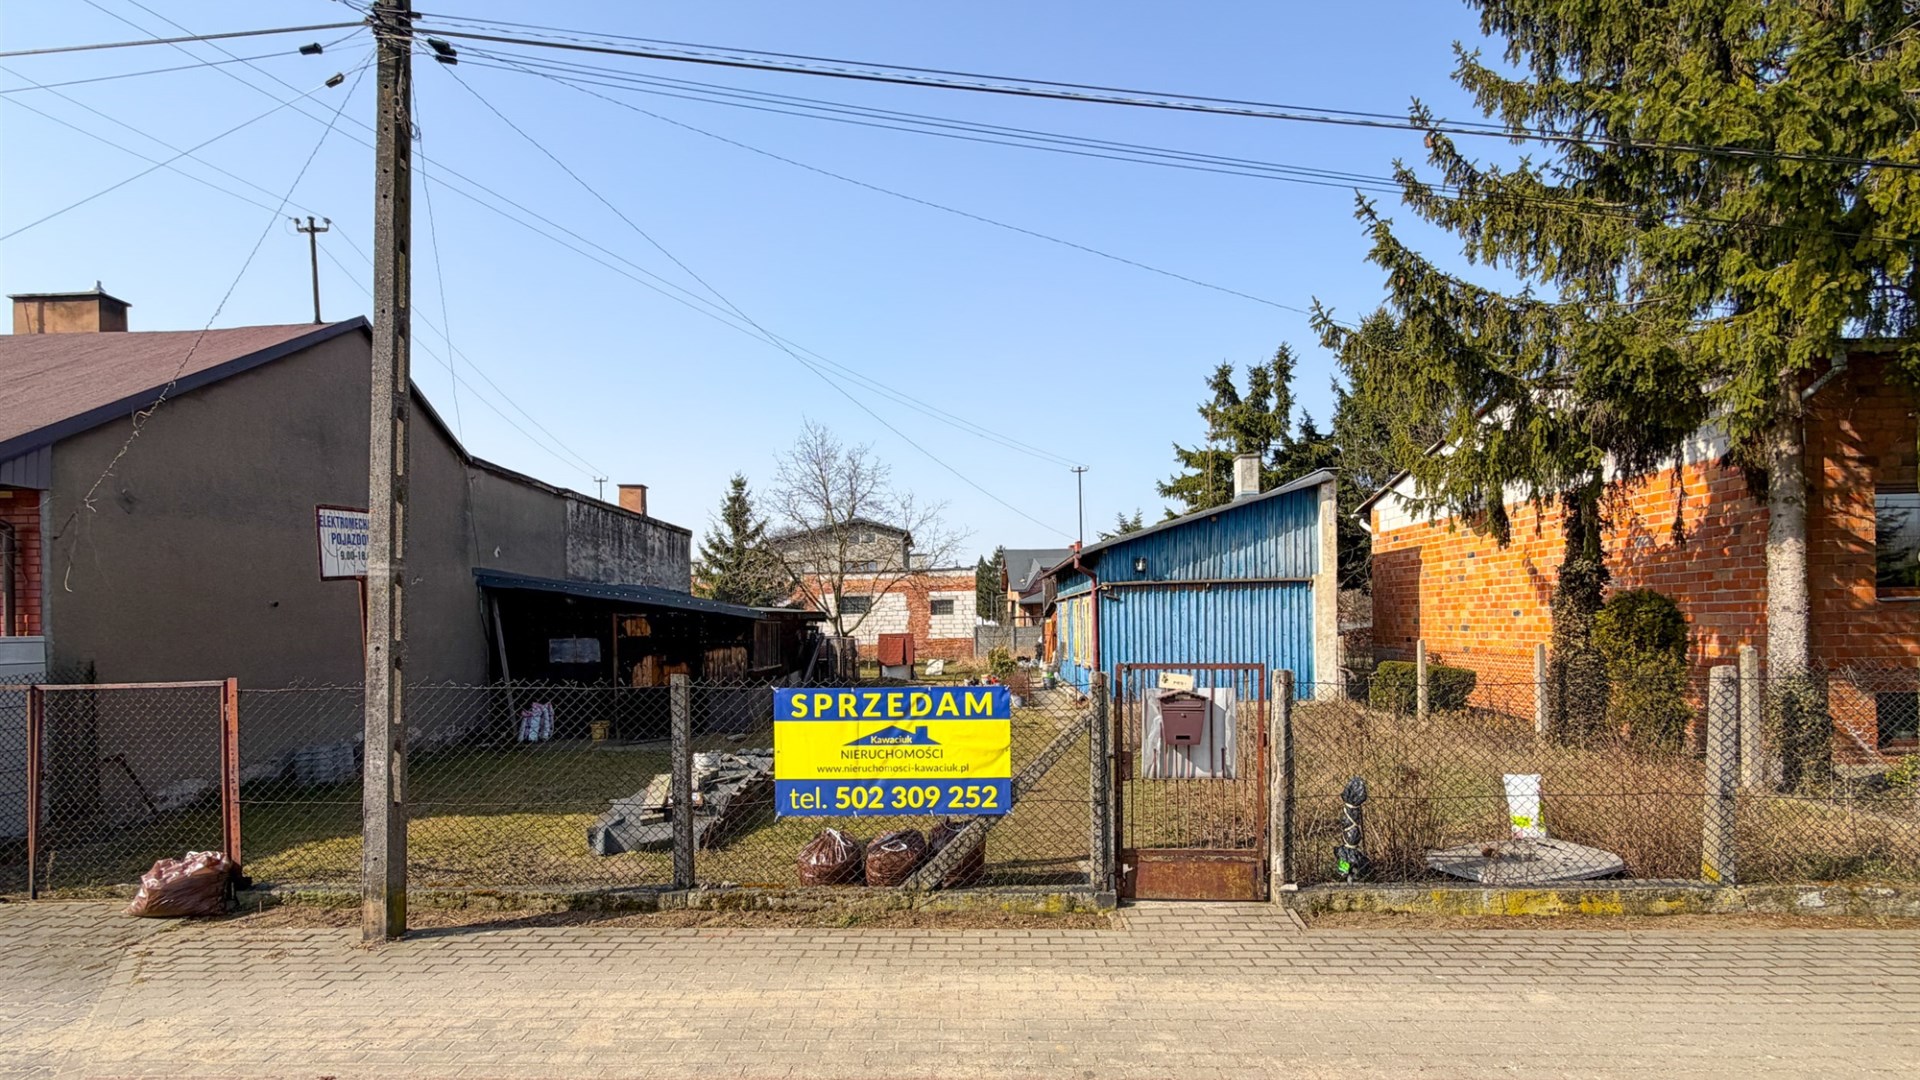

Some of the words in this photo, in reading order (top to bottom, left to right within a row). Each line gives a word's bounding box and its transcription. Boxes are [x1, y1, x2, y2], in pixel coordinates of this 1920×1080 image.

[320, 515, 369, 529] ELEKTROMECH
[331, 533, 368, 545] POJAZDO
[340, 551, 369, 560] 9.00-18.
[791, 692, 993, 718] SPRZEDAM
[870, 736, 912, 744] Kawaciuk
[841, 747, 943, 759] NIERUCHOMOŚCI
[817, 764, 969, 774] www.nieruchomosci-kawaciuk.pl
[790, 787, 828, 809] tel.
[835, 786, 884, 809] 502
[891, 786, 941, 809] 309
[947, 785, 998, 808] 252
